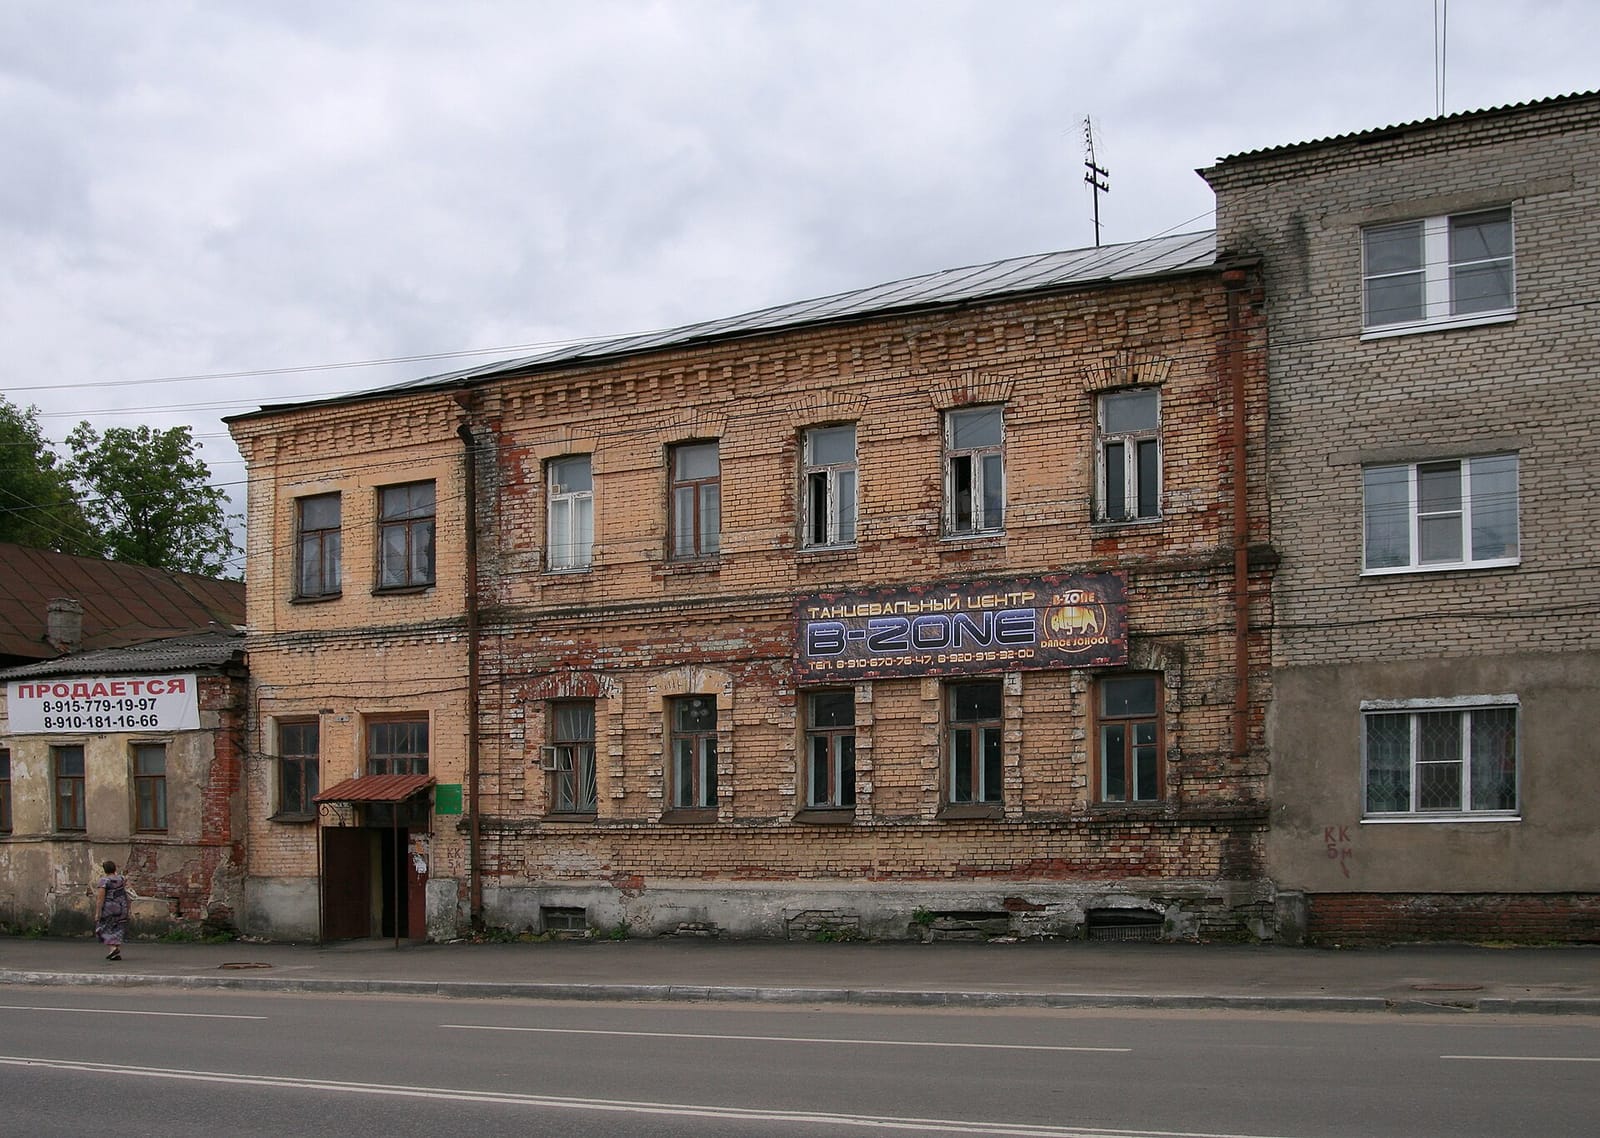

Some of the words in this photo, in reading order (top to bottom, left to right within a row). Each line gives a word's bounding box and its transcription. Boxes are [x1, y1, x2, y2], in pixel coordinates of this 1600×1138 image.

[807, 593, 960, 619] ТАНЦЕВАЛЬНЫЙ
[967, 591, 1036, 610] ЦЕНТР
[806, 608, 1036, 657] B-ZONE
[18, 678, 187, 700] ПРОДАЕТСЯ
[43, 698, 157, 713] 8-915-779-19-97
[44, 714, 159, 728] 8-910-181-16-66
